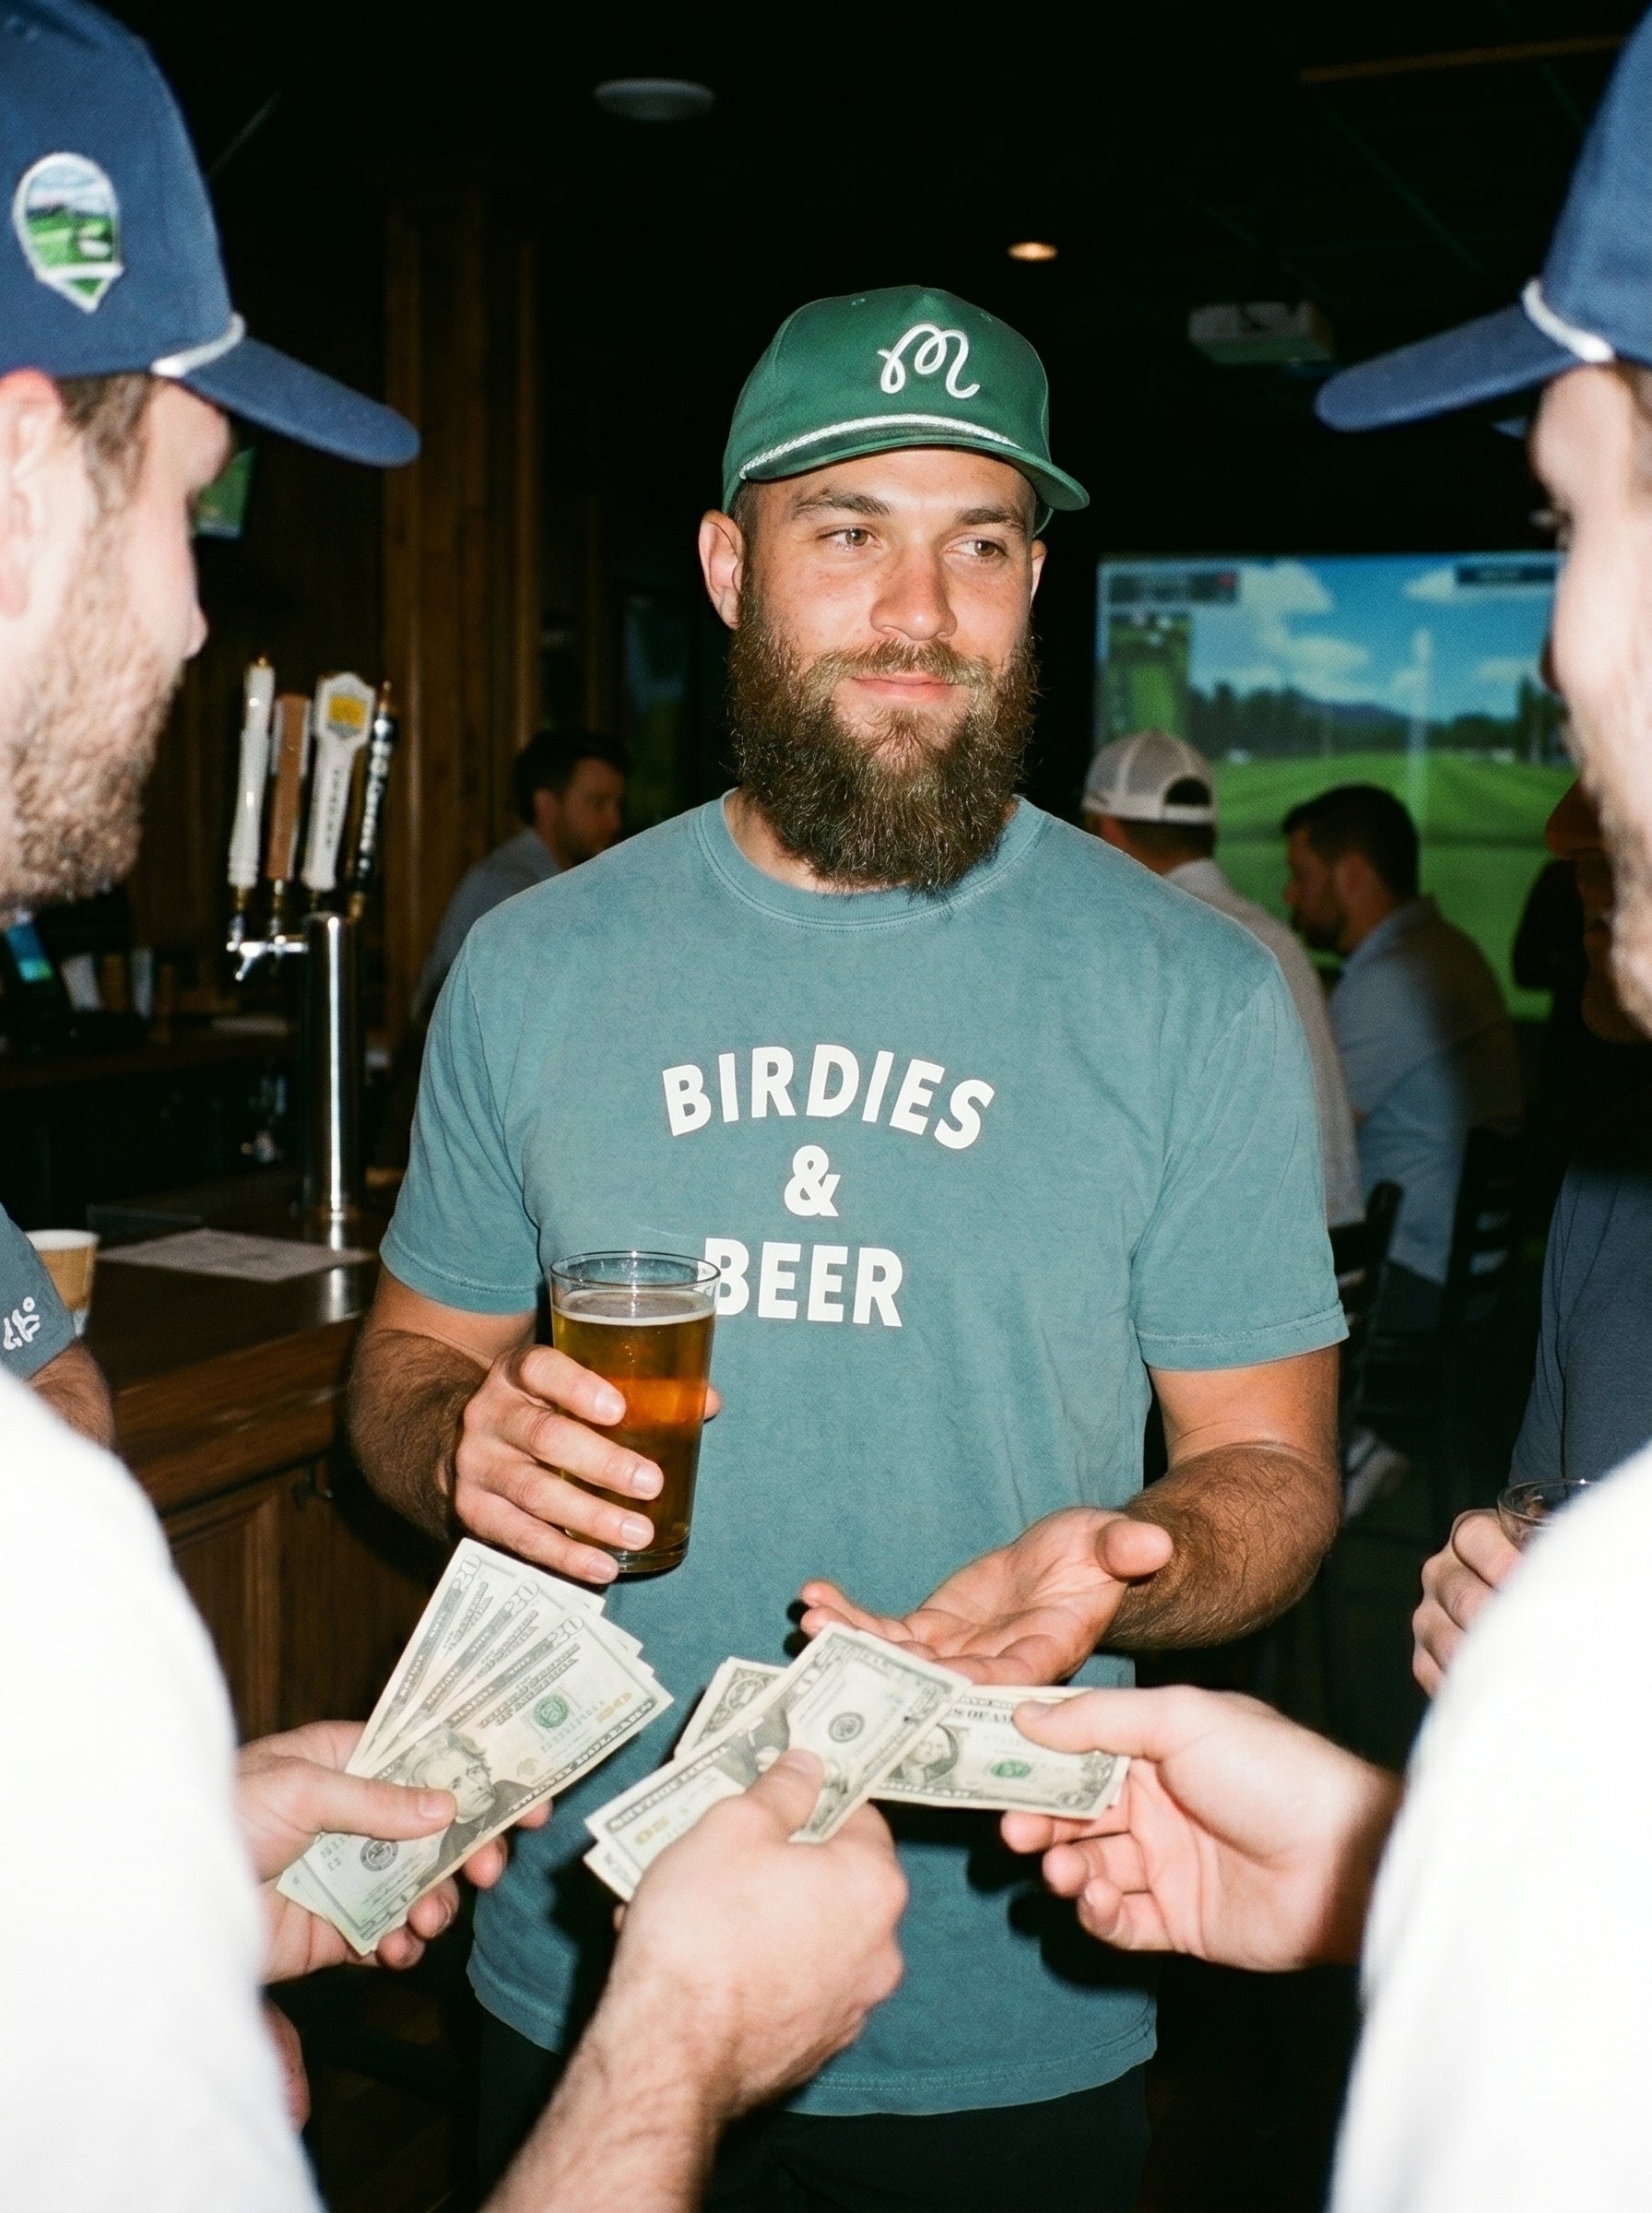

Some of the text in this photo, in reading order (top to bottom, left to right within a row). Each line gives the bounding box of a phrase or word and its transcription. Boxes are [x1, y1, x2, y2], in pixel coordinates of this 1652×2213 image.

[662, 1044, 995, 1150] BIRDIES
[784, 1144, 841, 1216] &
[705, 1237, 903, 1328] BEER
